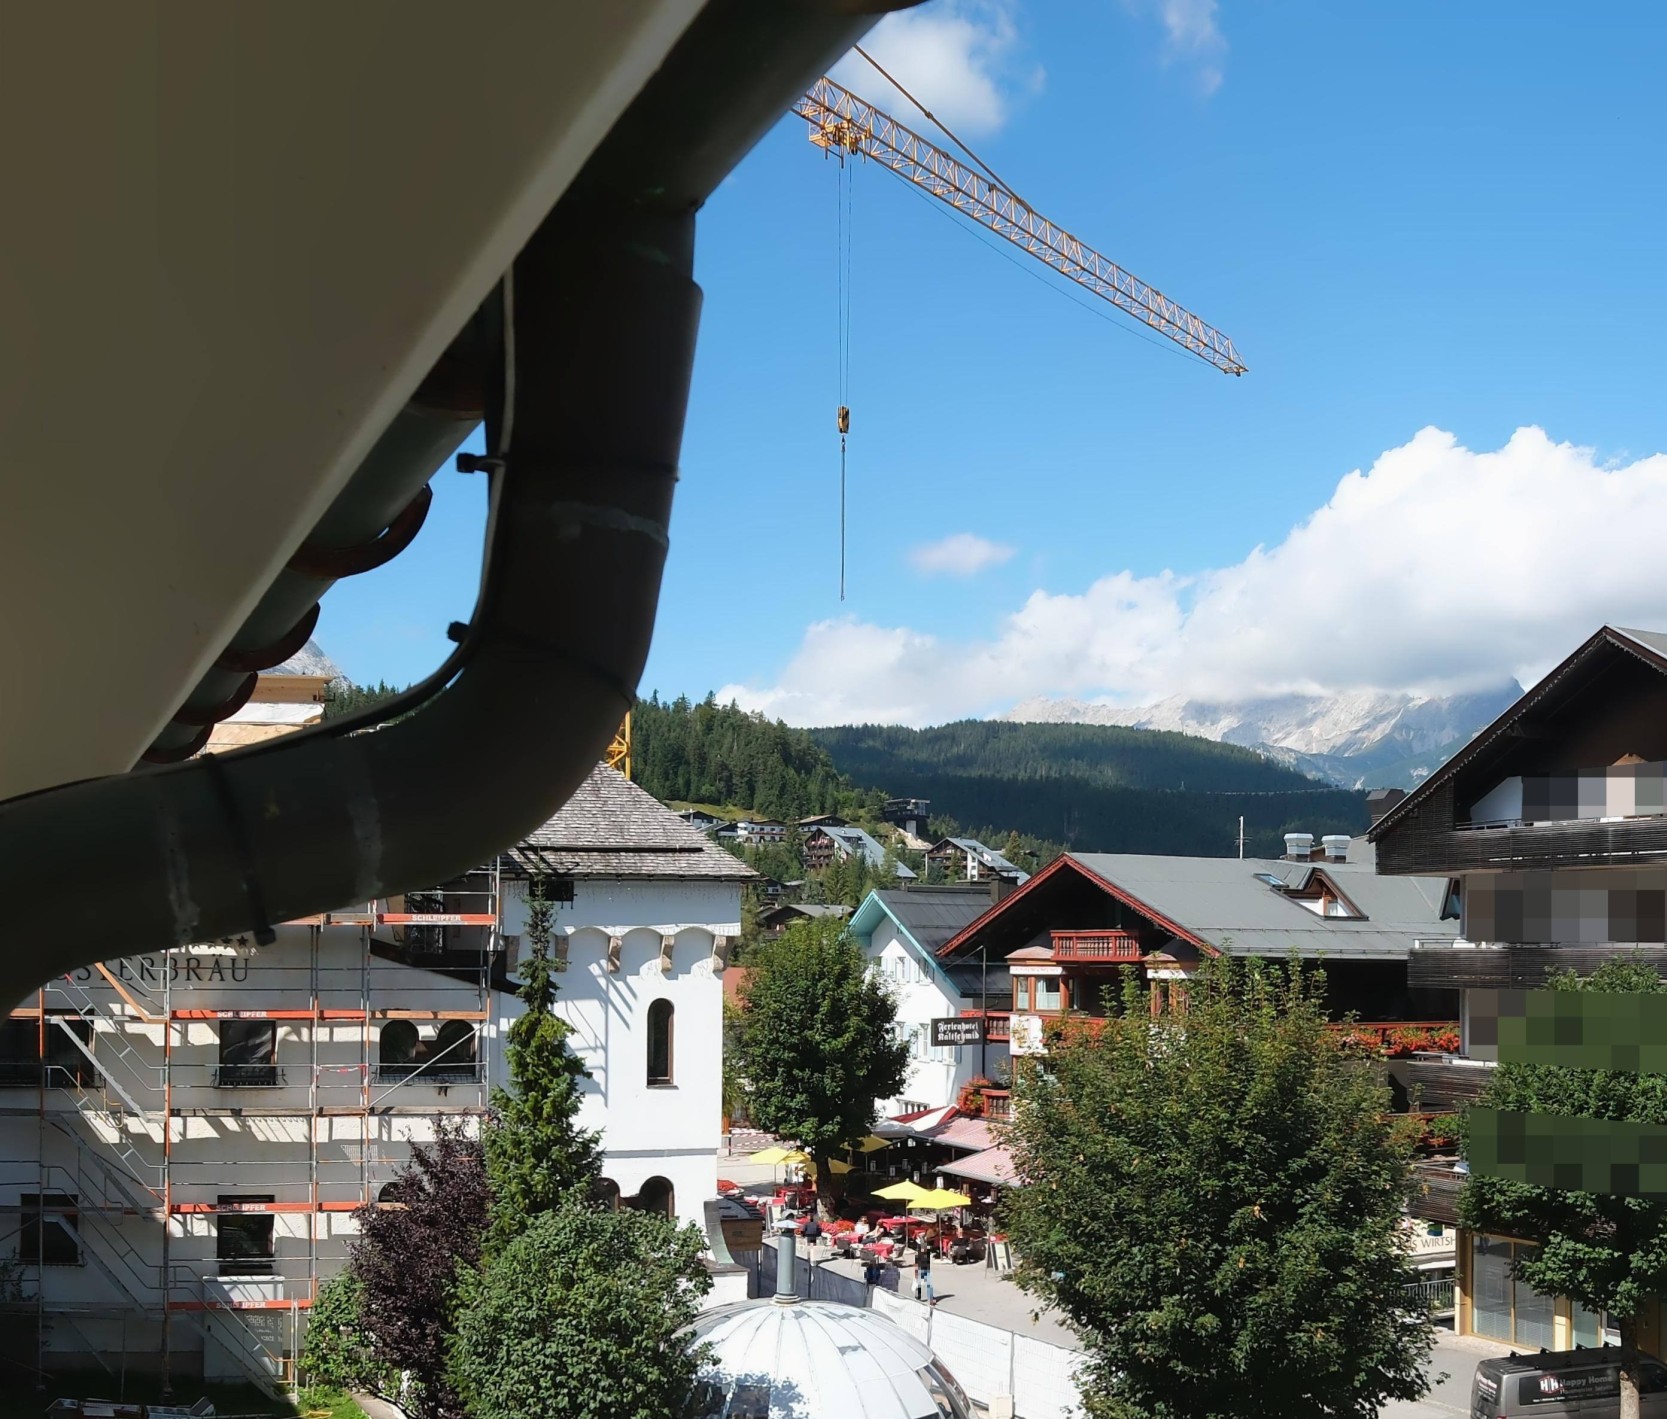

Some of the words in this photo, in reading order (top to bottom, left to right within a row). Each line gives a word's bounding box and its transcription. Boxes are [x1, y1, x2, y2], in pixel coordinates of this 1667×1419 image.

[412, 914, 462, 922] SCHLEIPFER
[217, 1010, 268, 1018] SCHLEIPFER
[1560, 1377, 1587, 1388] Happy
[1588, 1374, 1613, 1384] Home
